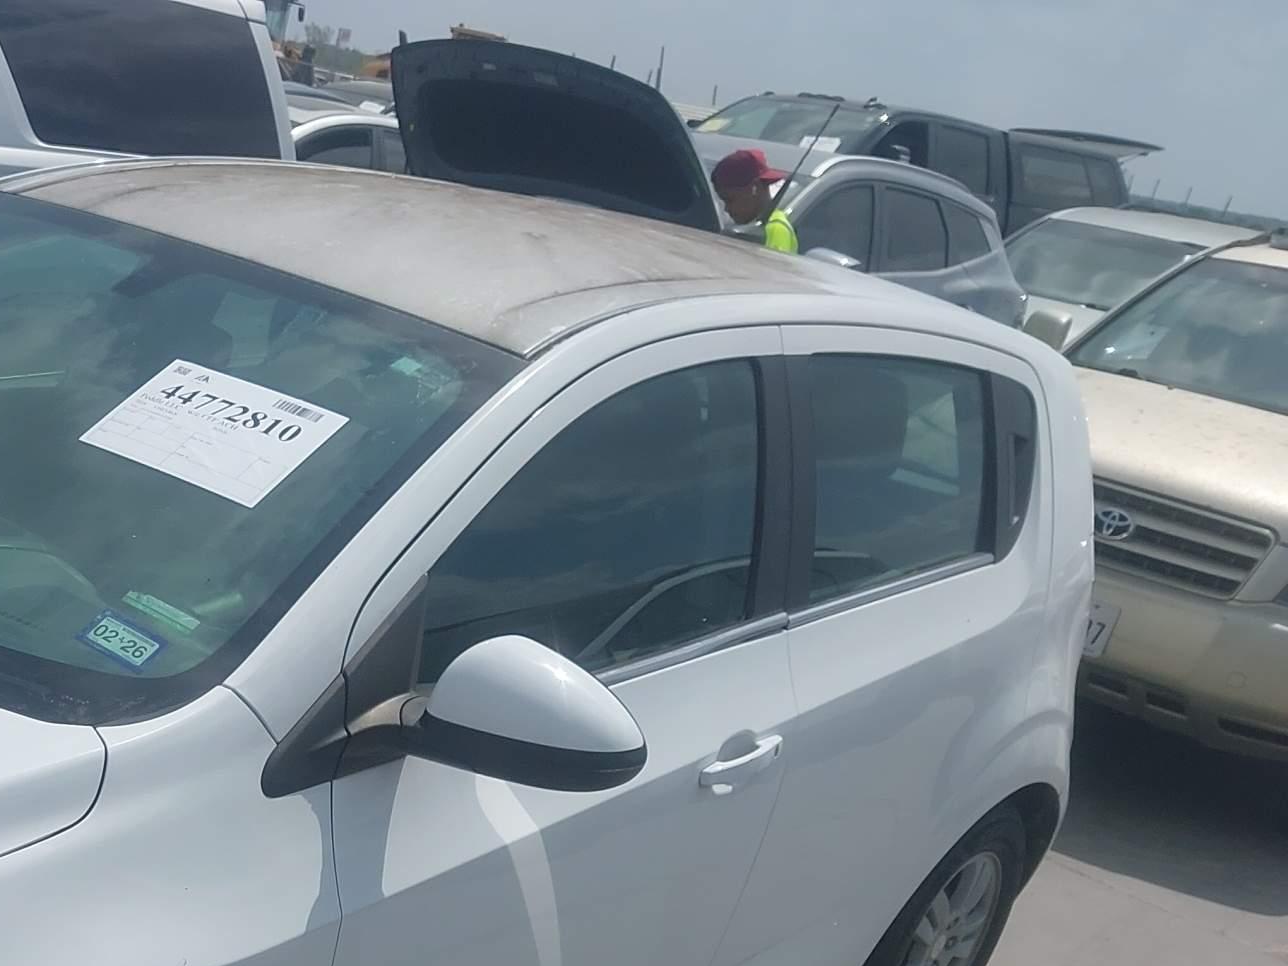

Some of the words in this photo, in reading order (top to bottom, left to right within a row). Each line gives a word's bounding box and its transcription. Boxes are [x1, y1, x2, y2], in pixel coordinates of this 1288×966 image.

[160, 384, 303, 442] 44772810
[93, 624, 119, 643] 02
[120, 639, 148, 658] 26
